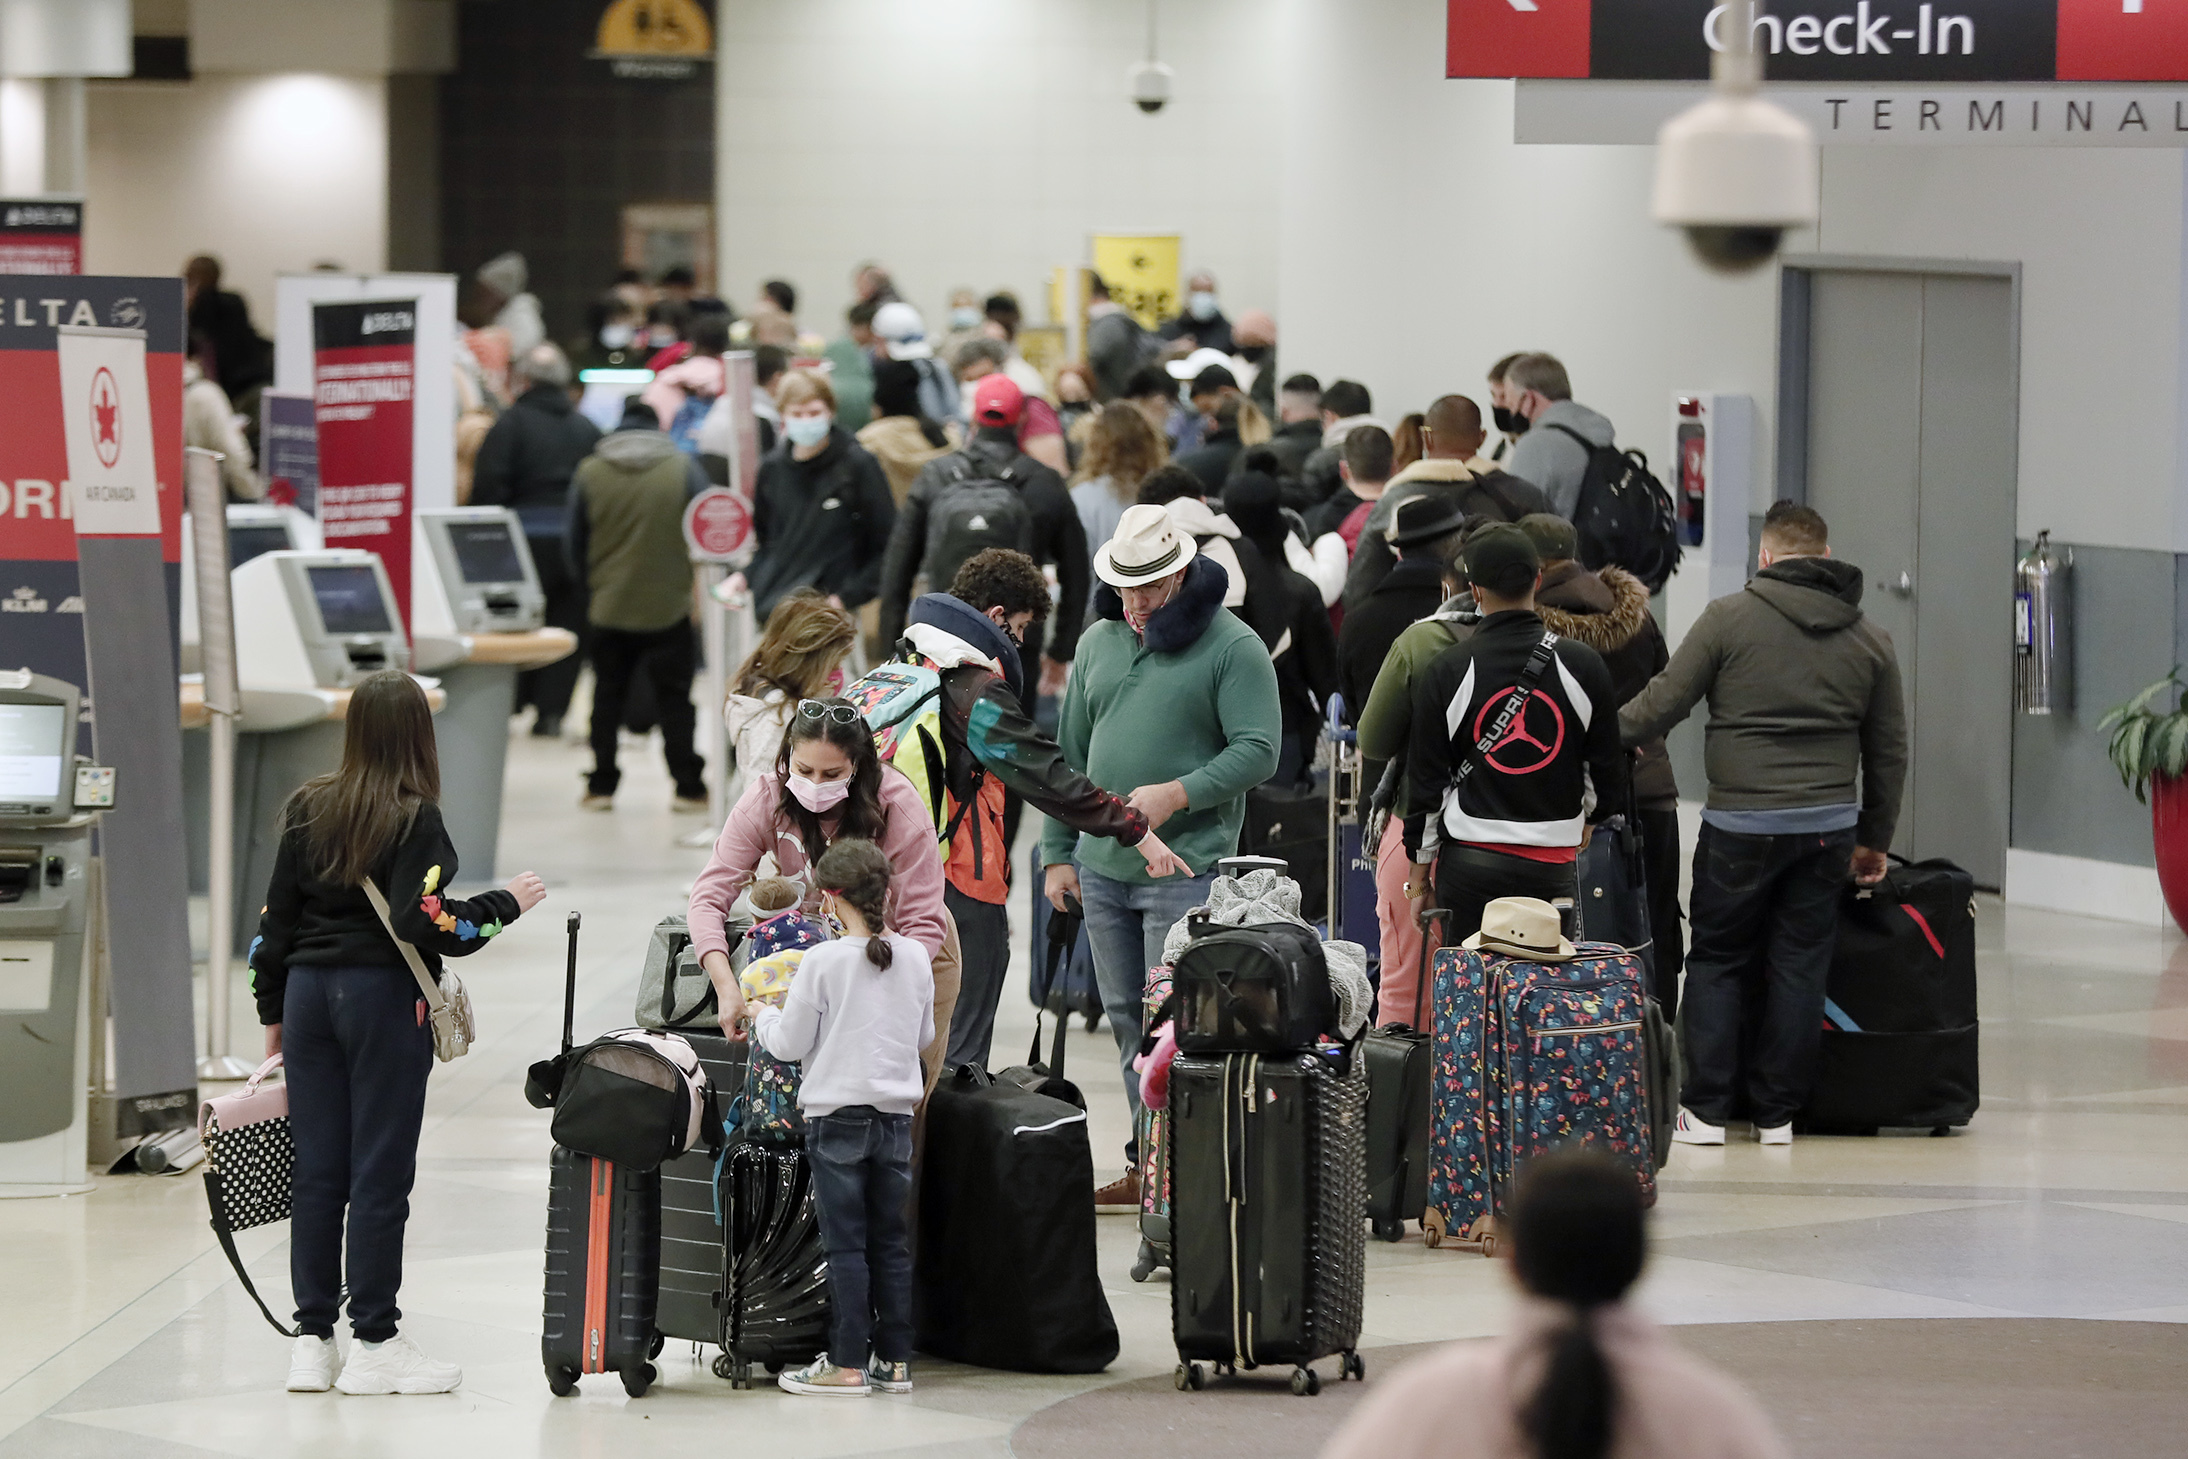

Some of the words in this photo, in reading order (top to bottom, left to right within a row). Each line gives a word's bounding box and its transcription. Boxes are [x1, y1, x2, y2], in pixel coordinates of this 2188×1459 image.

[1703, 0, 1975, 55] Check-In
[1824, 99, 2188, 132] TERMINAL
[0, 297, 99, 327] LTA
